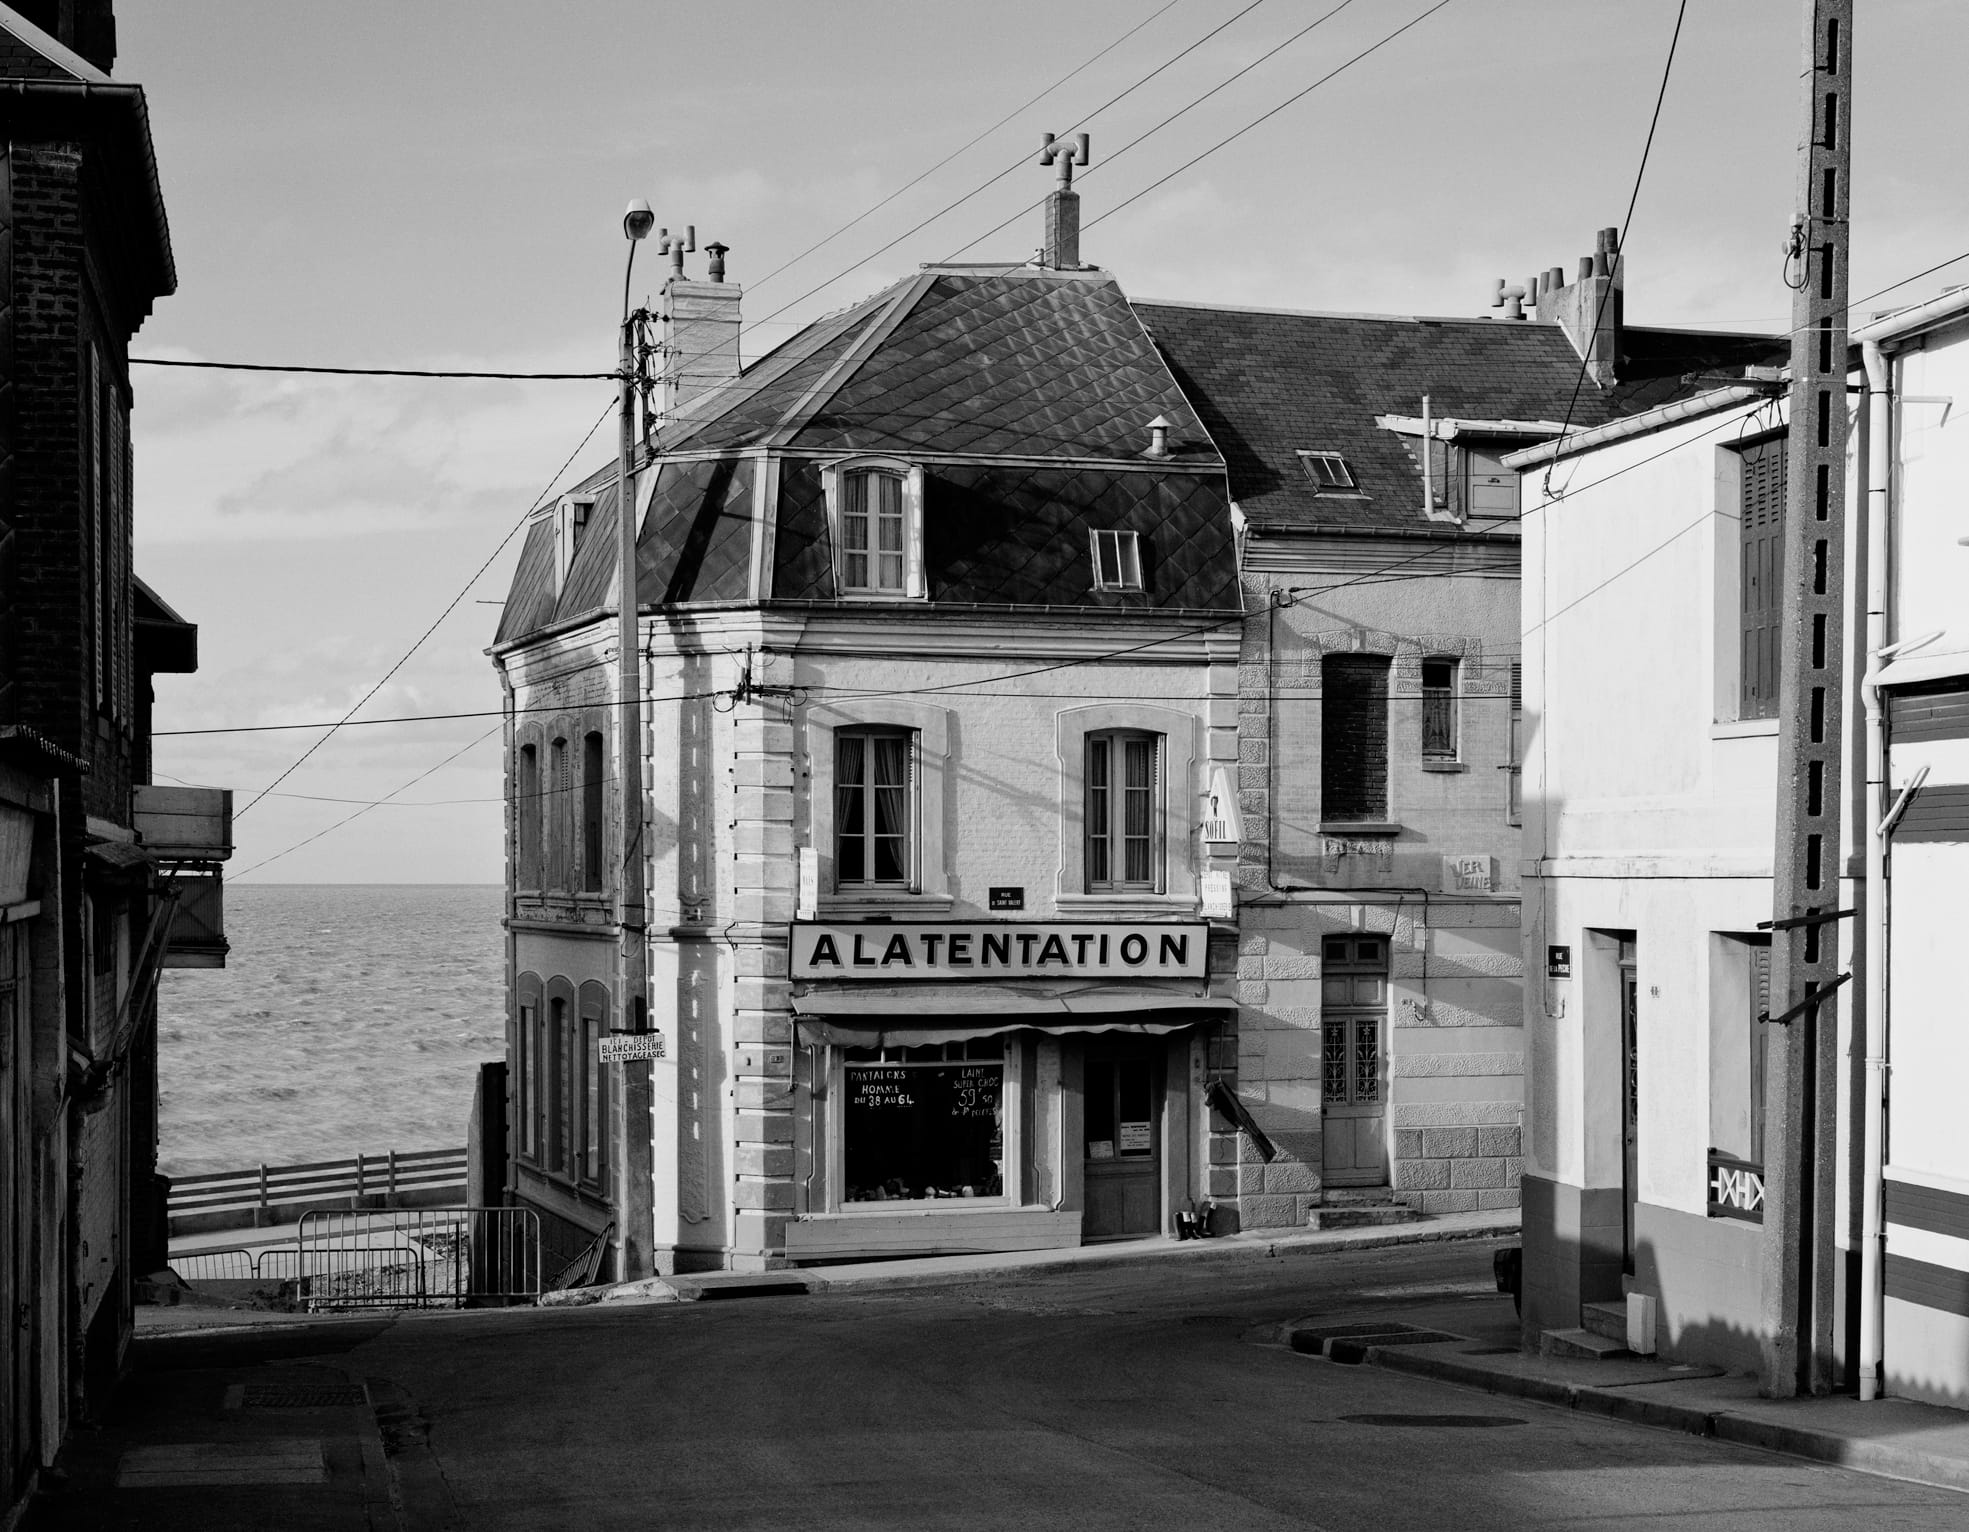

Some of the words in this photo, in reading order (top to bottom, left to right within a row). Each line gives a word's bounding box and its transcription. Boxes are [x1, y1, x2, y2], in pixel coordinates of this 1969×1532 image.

[602, 1042, 663, 1053] BLANCHISSERIE
[861, 1084, 900, 1095] HOMME
[854, 1096, 866, 1104] DU
[868, 1095, 881, 1107] 38
[884, 1096, 897, 1104] AU
[898, 1094, 915, 1105] 64
